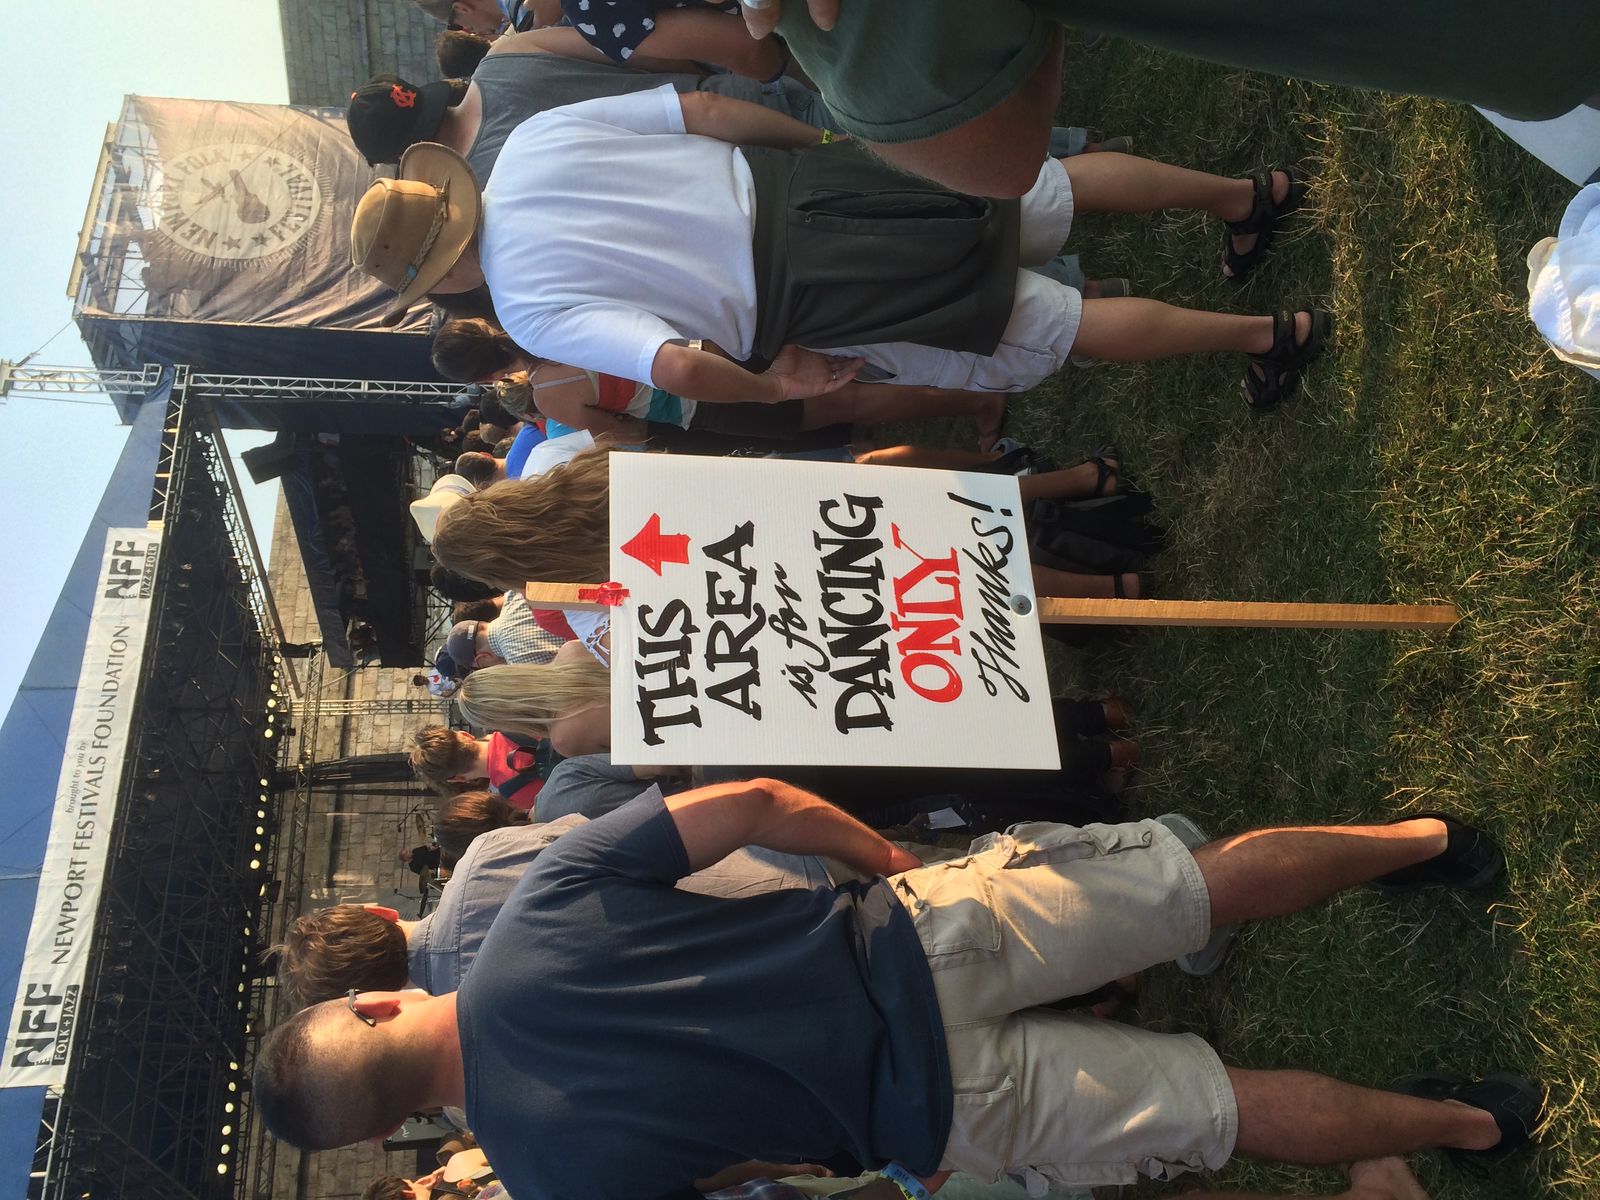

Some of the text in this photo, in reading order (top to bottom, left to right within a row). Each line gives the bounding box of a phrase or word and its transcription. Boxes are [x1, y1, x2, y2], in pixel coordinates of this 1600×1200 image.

[268, 163, 312, 242] FESTIVAL
[104, 540, 145, 598] NFF
[702, 520, 765, 720] AREA
[768, 562, 830, 709] is for
[813, 493, 895, 734] DANCING
[890, 523, 963, 703] ONLY
[946, 492, 1030, 703] Thanks!
[634, 599, 702, 746] THIS
[51, 624, 130, 965] NEWPORT FESTIVALS FOUNDATION
[65, 741, 88, 814] brought to you by
[11, 984, 62, 1067] NFF
